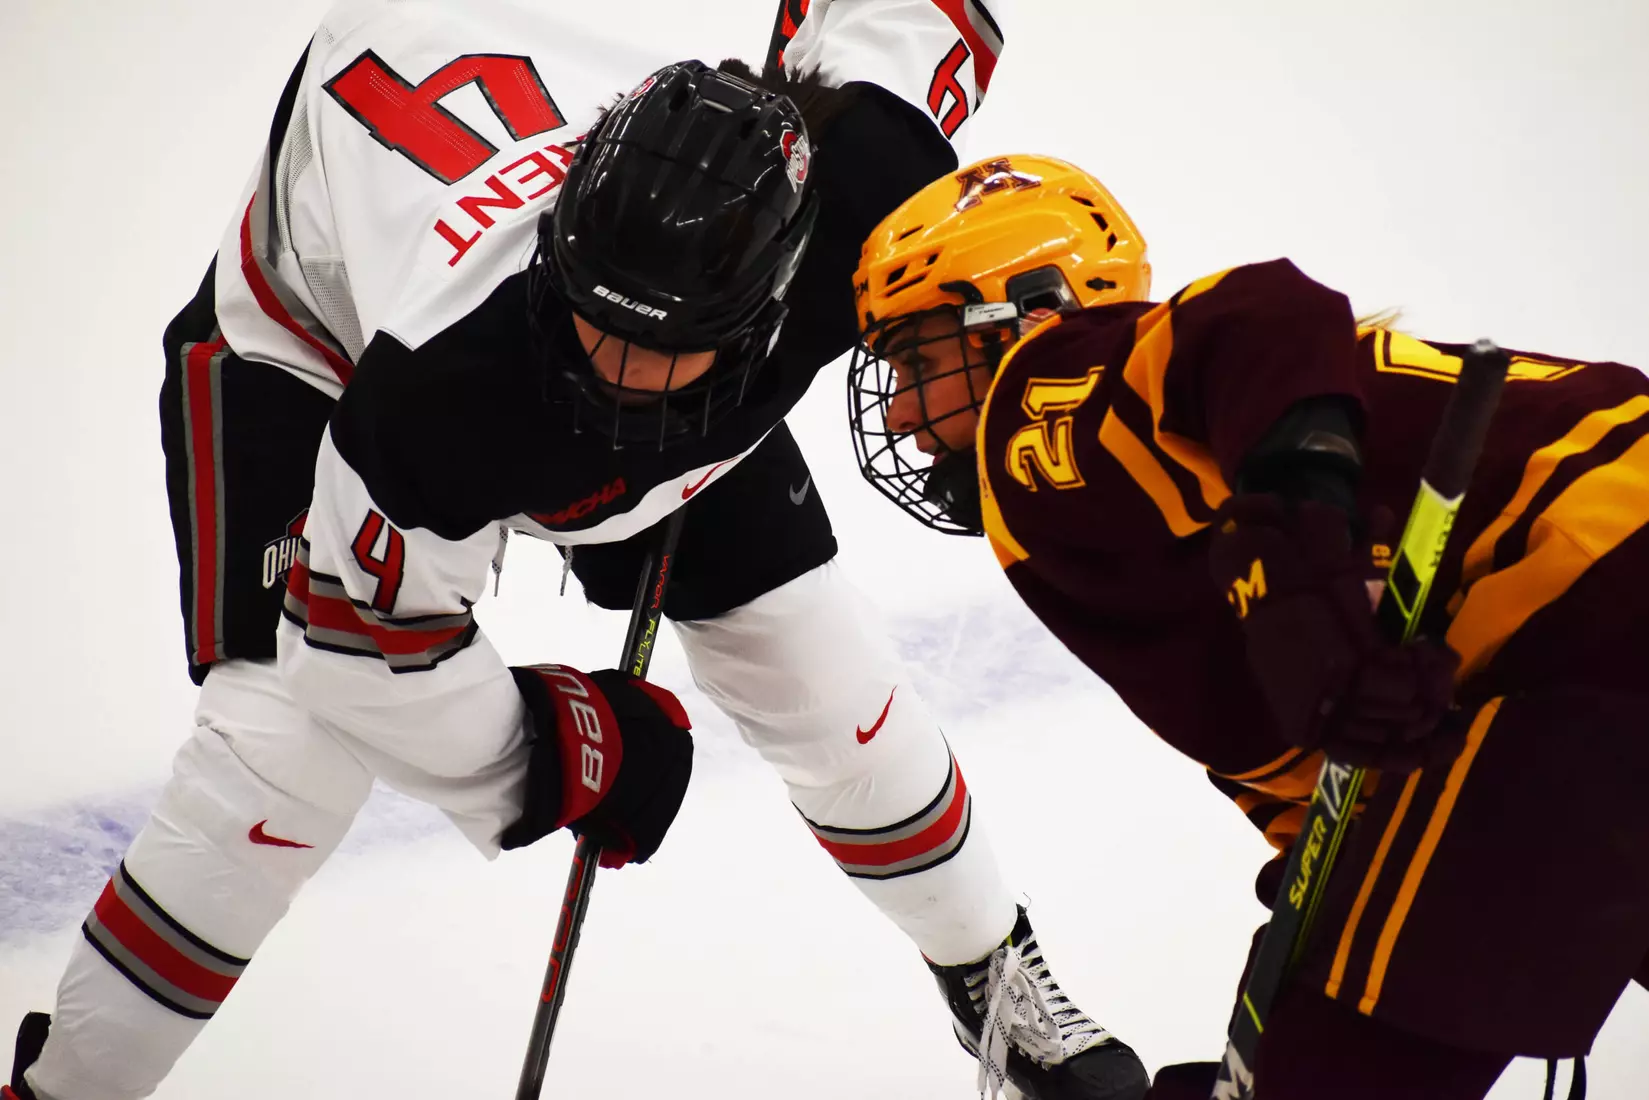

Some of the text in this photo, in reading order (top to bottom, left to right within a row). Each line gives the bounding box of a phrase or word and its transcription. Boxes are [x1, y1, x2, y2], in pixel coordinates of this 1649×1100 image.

[926, 37, 971, 140] 4
[1005, 365, 1105, 492] 21
[262, 536, 302, 590] OHI
[350, 507, 405, 615] 4
[522, 664, 604, 793] BAU
[1288, 814, 1328, 911] SUPER
